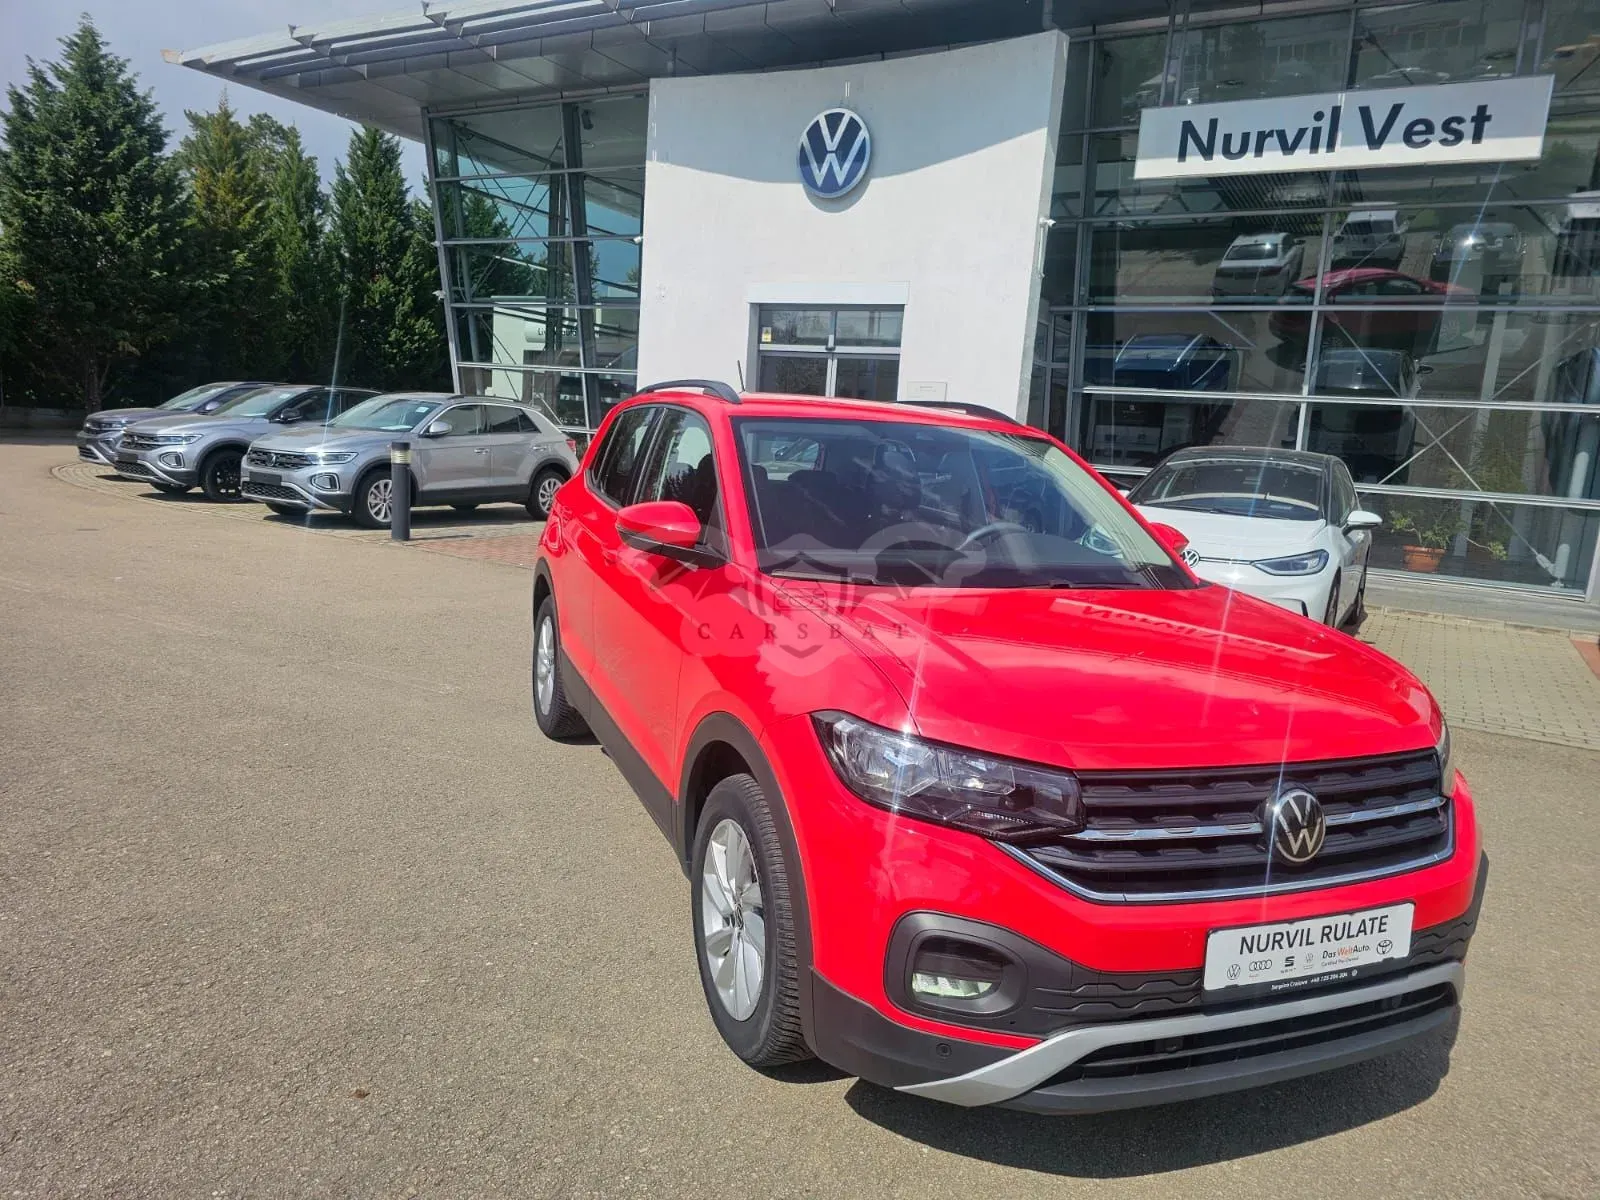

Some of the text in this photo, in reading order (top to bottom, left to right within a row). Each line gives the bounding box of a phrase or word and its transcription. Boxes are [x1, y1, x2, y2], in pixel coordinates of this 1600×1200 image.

[1177, 102, 1493, 163] Nurvil Vest
[1239, 914, 1389, 955] NURVIL RULATE
